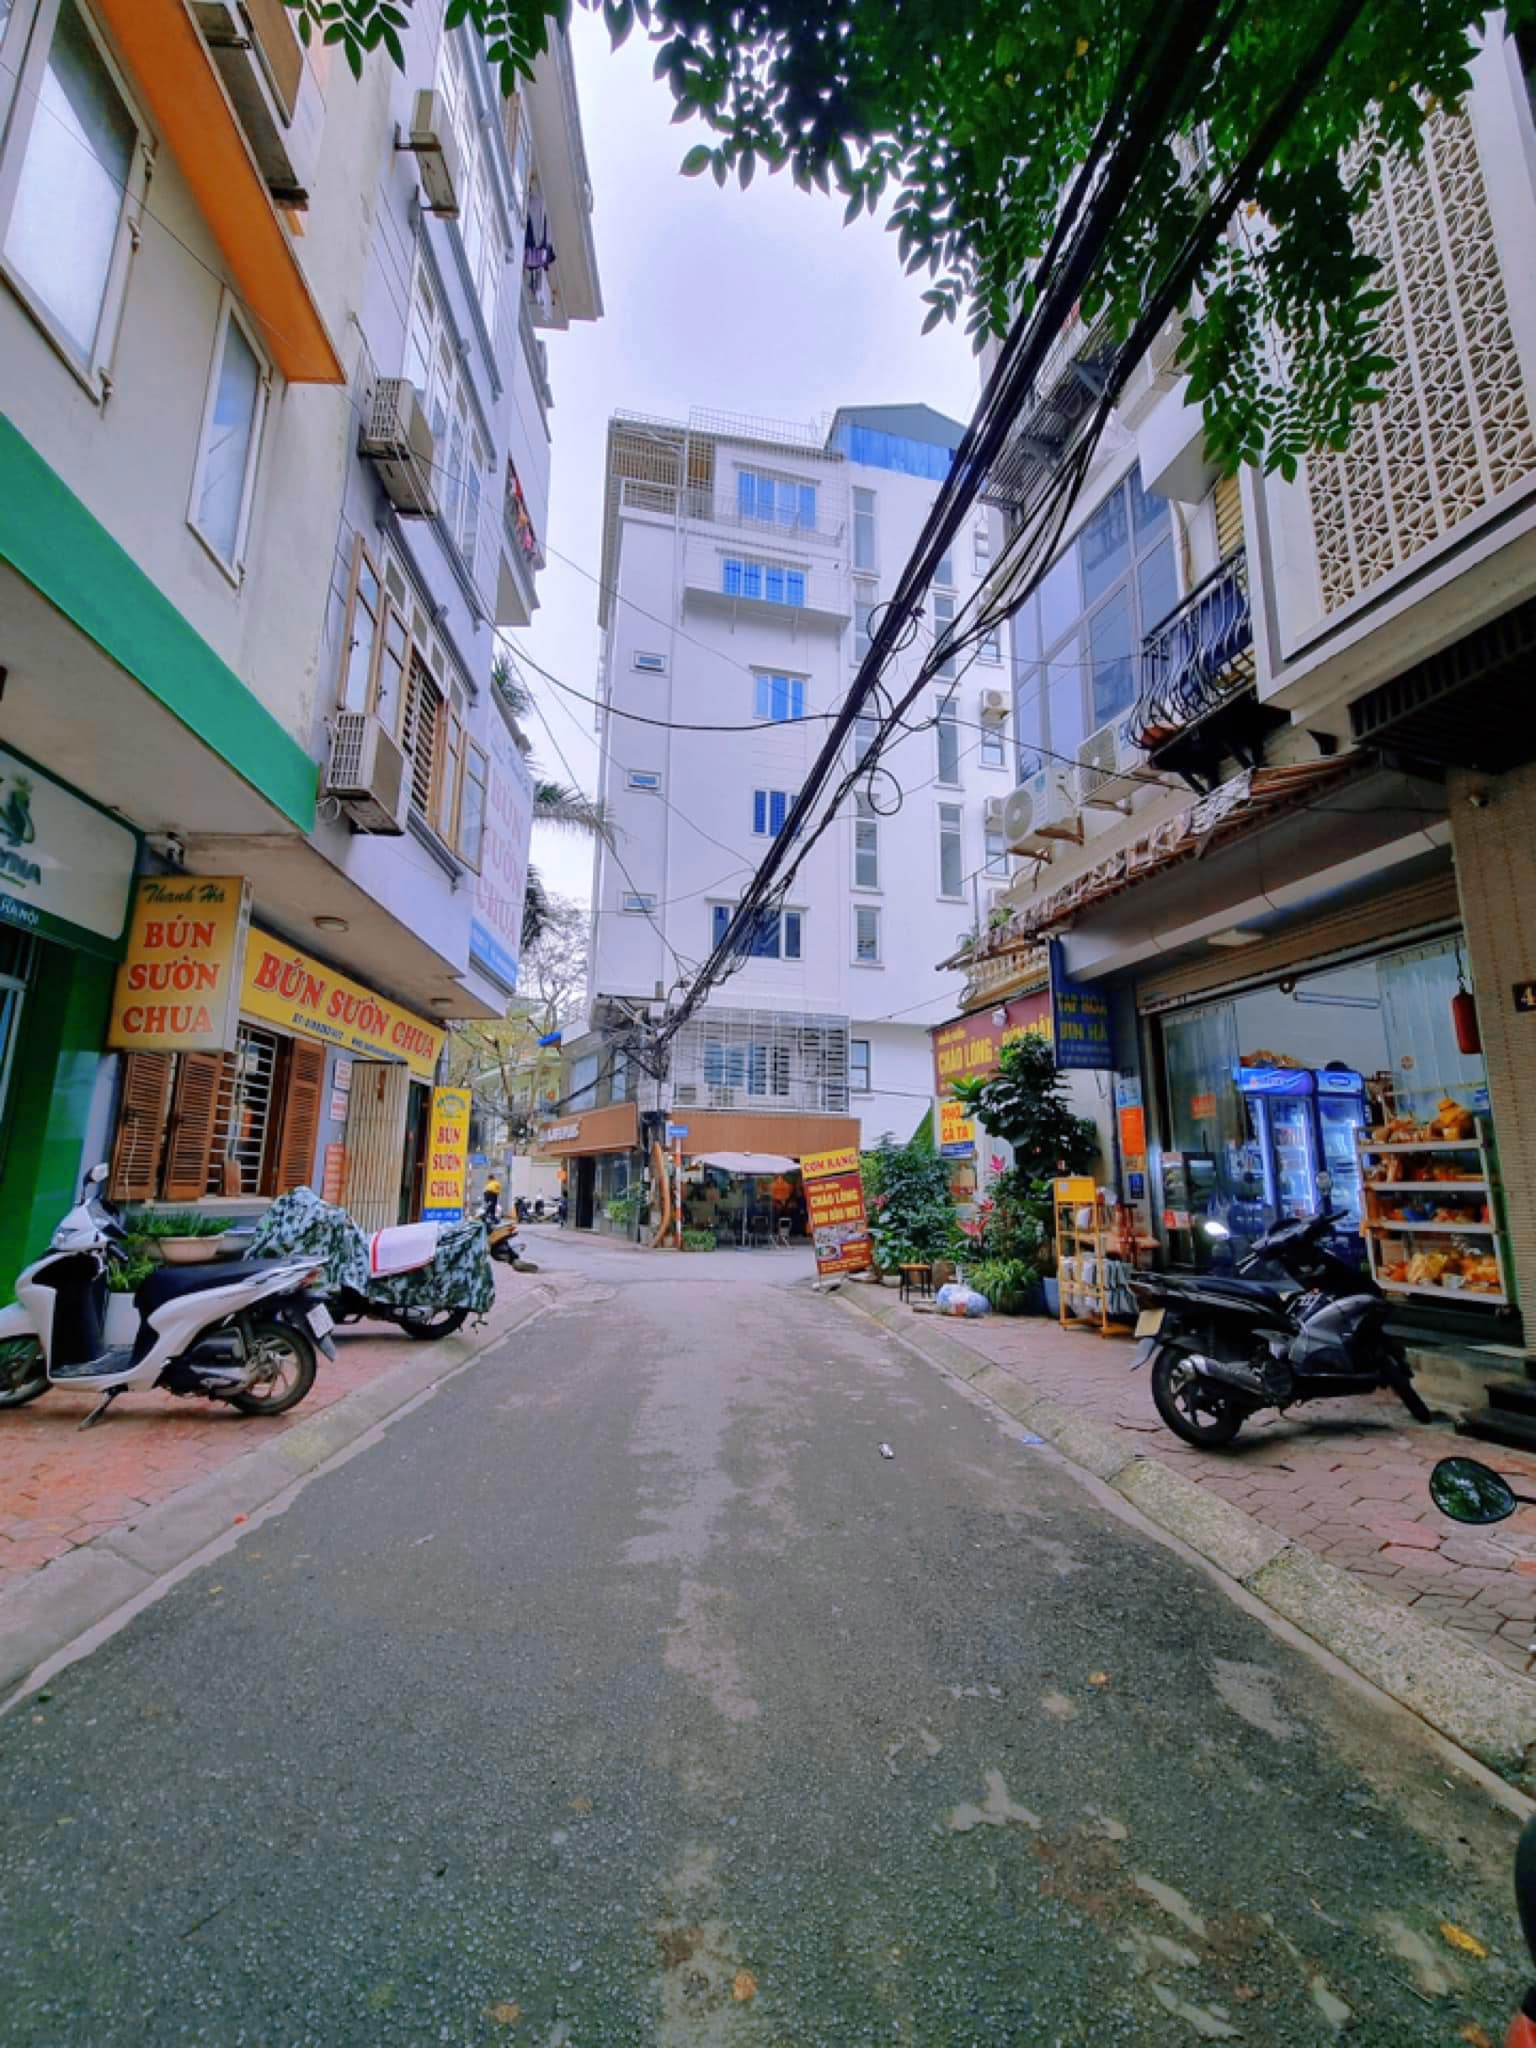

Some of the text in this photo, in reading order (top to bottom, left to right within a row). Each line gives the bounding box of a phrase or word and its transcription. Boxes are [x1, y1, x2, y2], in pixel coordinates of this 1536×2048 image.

[142, 882, 195, 904] Thanh
[143, 913, 217, 949] BÚN
[127, 955, 221, 992] SƯỜN
[121, 1005, 214, 1034] CHUA
[253, 951, 326, 1010] BÚN
[326, 988, 391, 1039] SƯỜN
[391, 1020, 436, 1061] CHUA
[436, 1121, 461, 1145] BÚN
[429, 1180, 460, 1198] CHUA
